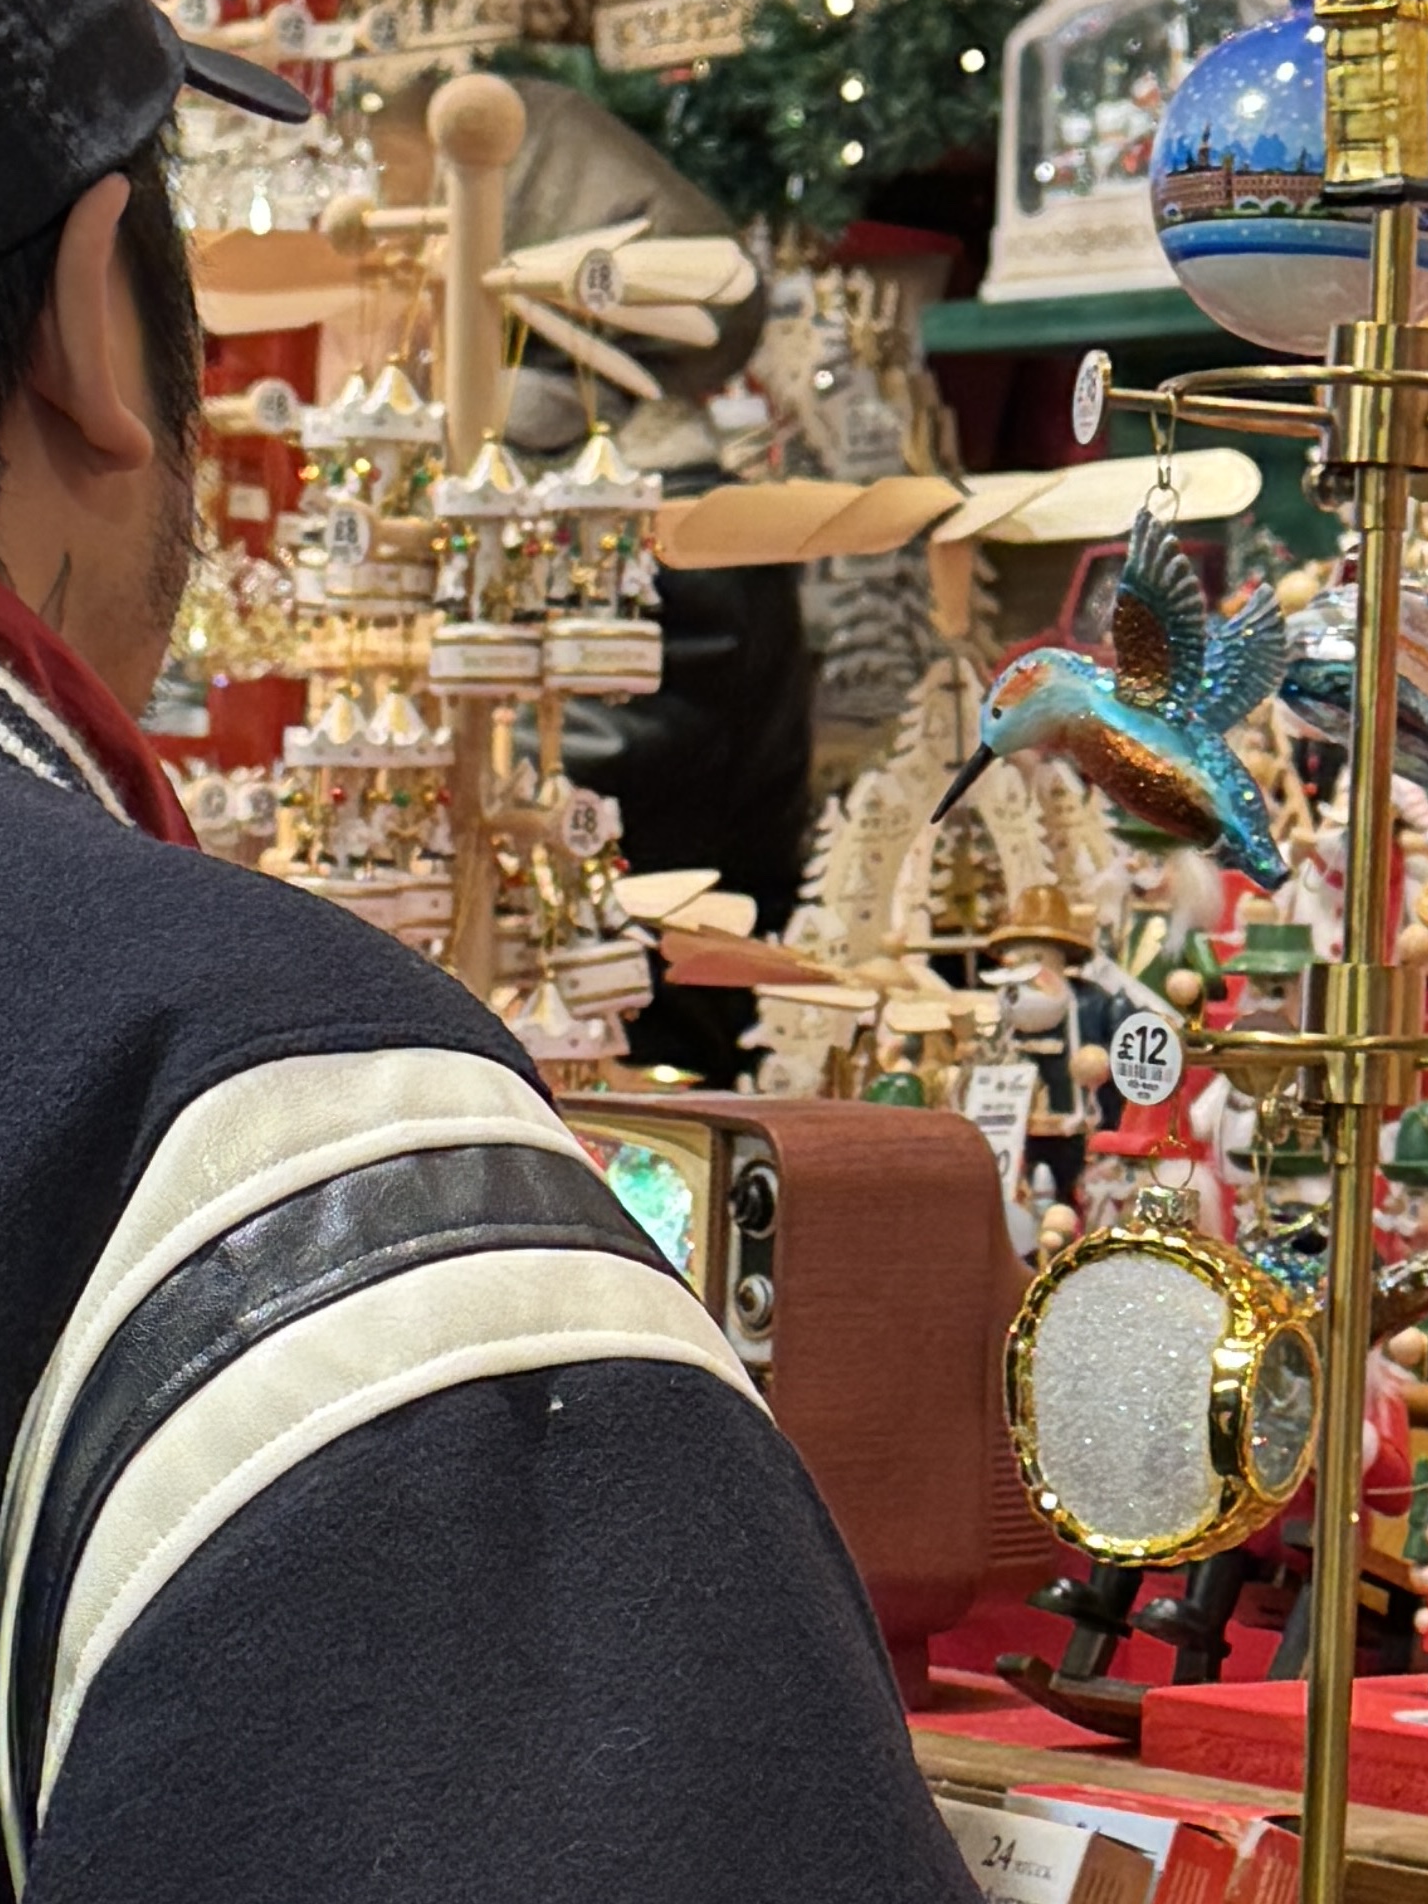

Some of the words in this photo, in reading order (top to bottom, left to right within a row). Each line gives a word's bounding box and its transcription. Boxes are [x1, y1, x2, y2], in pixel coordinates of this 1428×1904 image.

[571, 805, 600, 835] £8
[1117, 1024, 1169, 1067] £12
[980, 1834, 1018, 1872] 24
